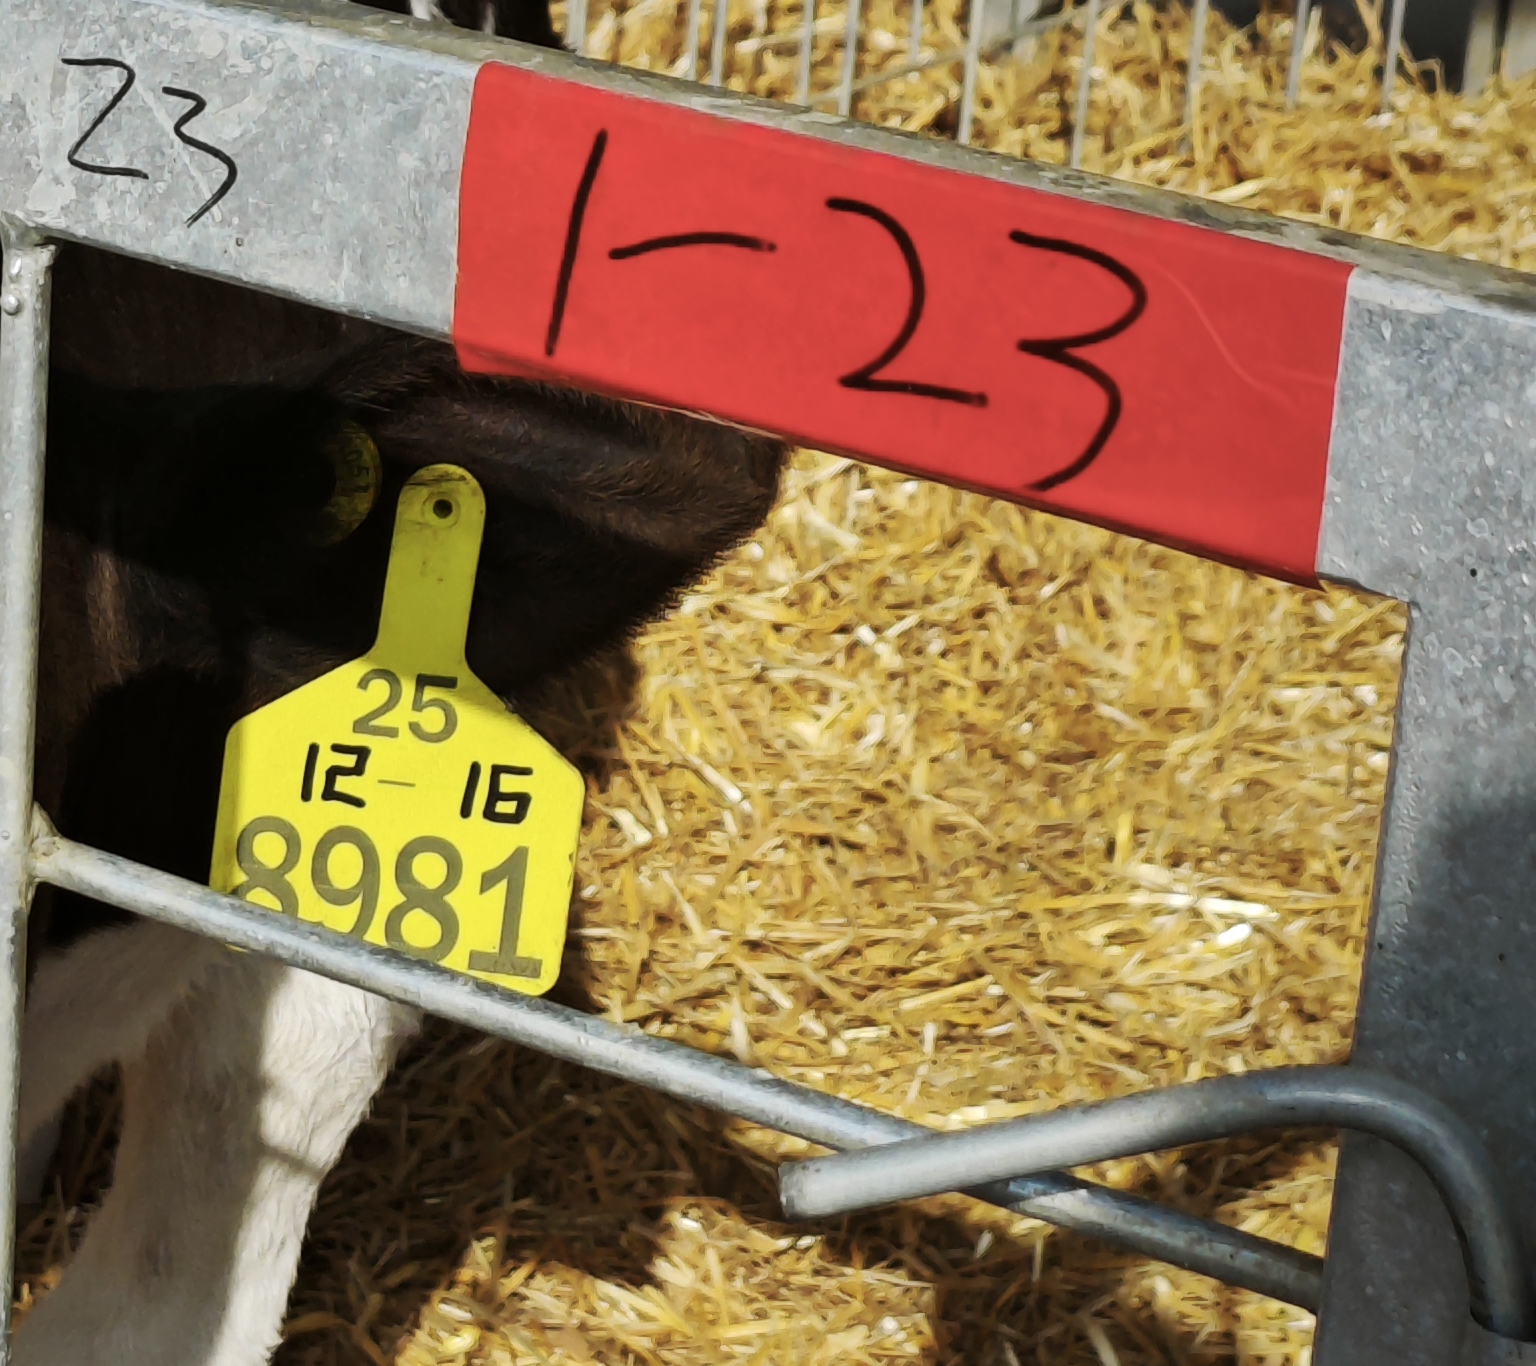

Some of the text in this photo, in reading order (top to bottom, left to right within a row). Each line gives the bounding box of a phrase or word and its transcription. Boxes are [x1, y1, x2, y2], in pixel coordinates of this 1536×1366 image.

[61, 55, 238, 228] 23
[352, 668, 459, 744] 25
[235, 815, 544, 981] 8981
